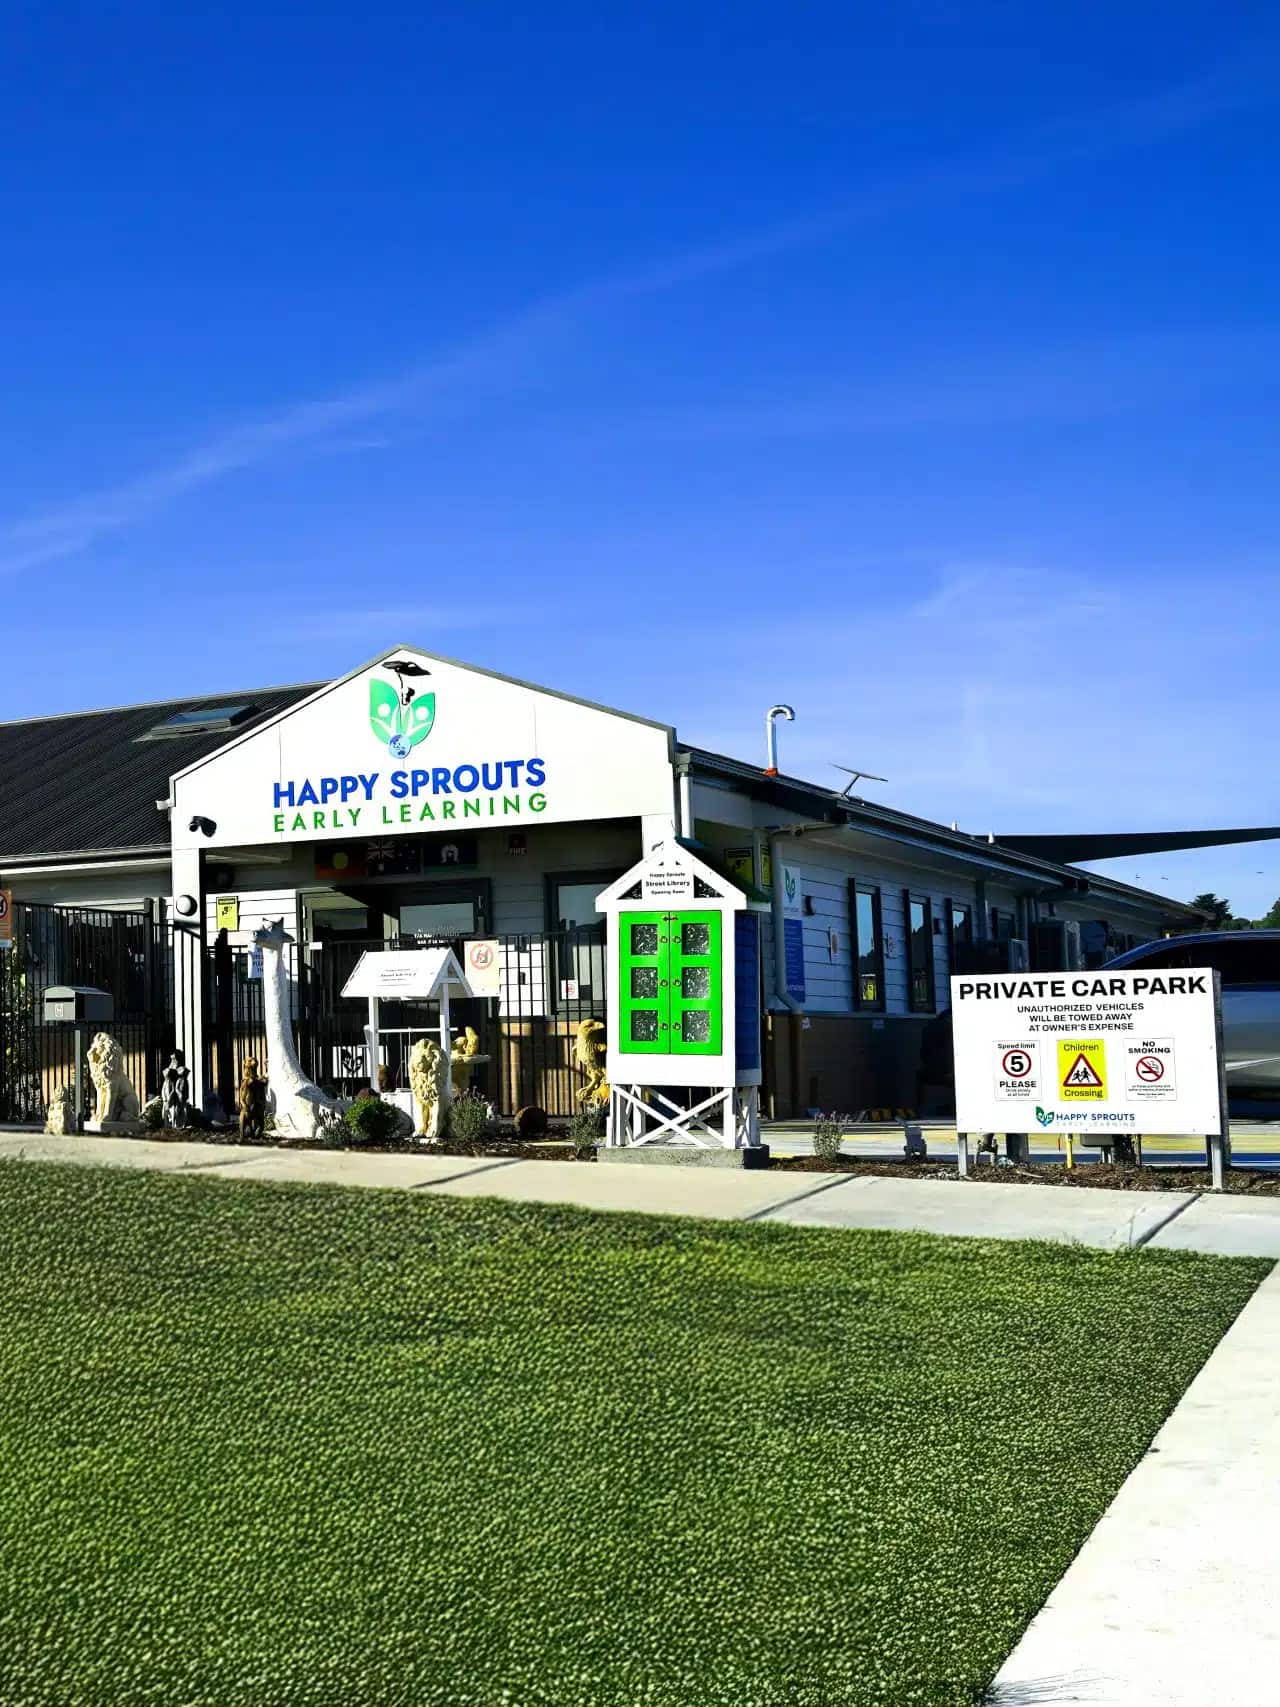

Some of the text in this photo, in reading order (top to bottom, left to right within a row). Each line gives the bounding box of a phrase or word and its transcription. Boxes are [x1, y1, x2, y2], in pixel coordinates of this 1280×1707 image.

[274, 758, 546, 808] HAPPY SPROUTS
[274, 793, 547, 833] EARLY LEARNING
[959, 976, 1207, 999] PRIVATE CAR PARK
[1017, 1003, 1144, 1013] UNAUTHORIZED VEHICLES
[1068, 1013, 1103, 1021] TOWED
[1042, 1023, 1087, 1031] OWNER'S
[1088, 1022, 1134, 1030] EXPENSE
[1063, 1043, 1099, 1052] Children
[1010, 1055, 1024, 1072] 5
[1065, 1089, 1103, 1098] Crossing
